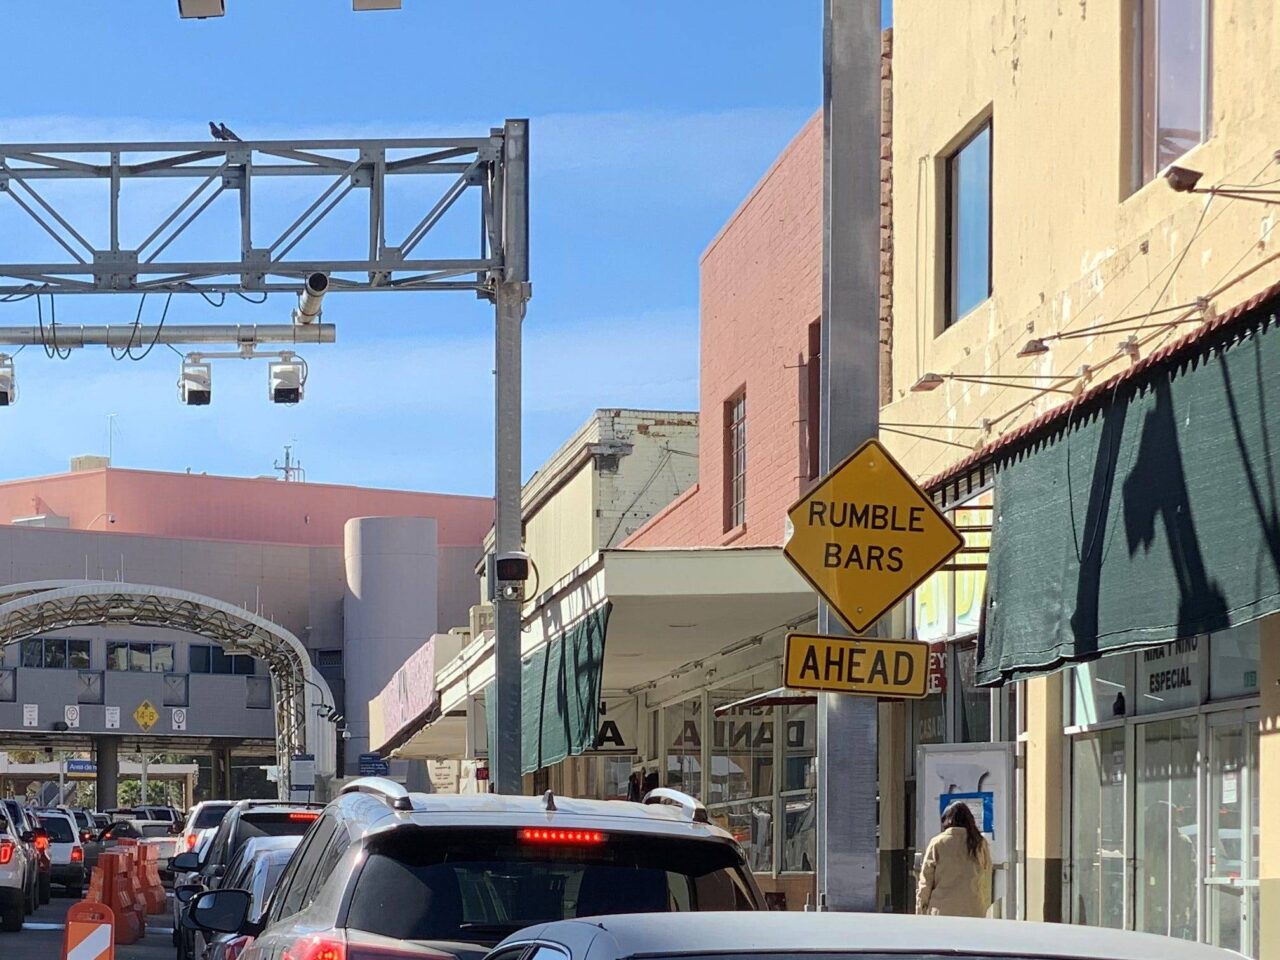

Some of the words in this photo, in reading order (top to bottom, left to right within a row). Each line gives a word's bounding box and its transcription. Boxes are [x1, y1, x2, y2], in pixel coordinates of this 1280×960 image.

[808, 500, 926, 533] RUMBLE
[823, 542, 904, 573] BARS
[799, 645, 915, 686] AHEAD
[1149, 665, 1192, 694] ESPECIAL
